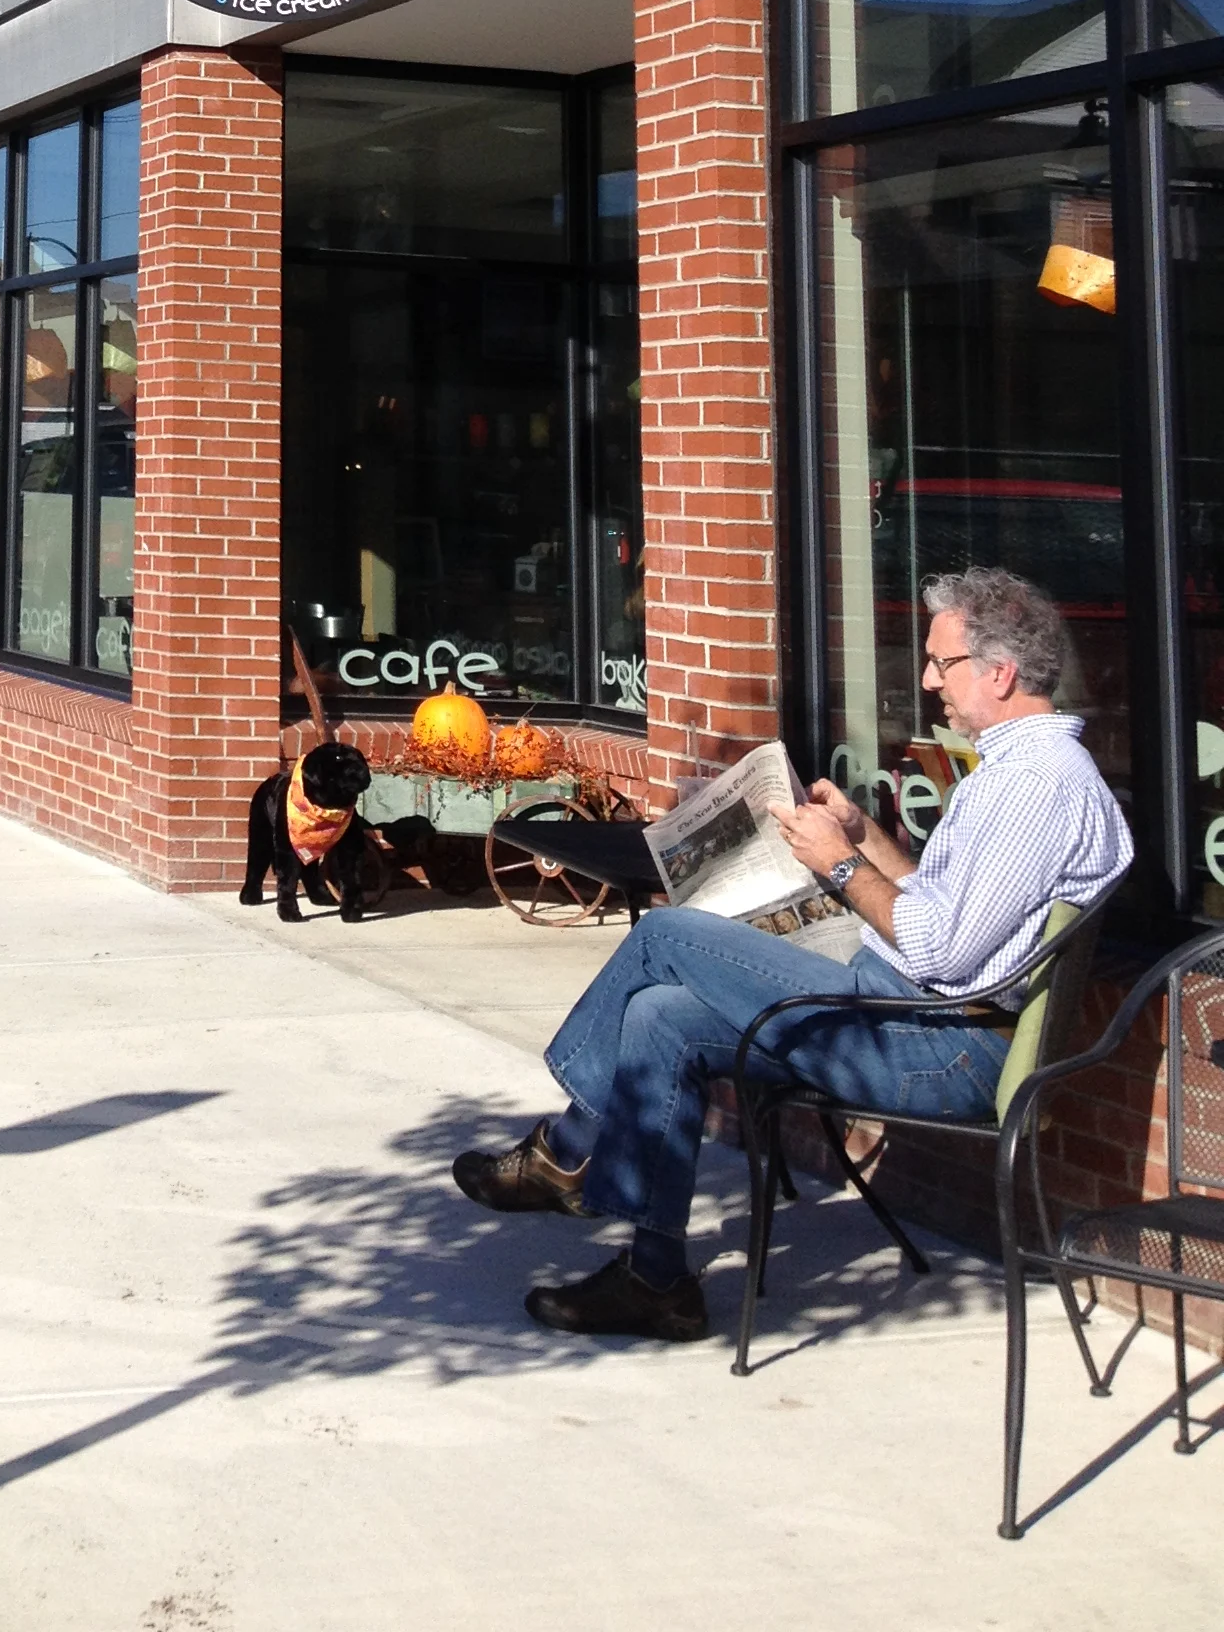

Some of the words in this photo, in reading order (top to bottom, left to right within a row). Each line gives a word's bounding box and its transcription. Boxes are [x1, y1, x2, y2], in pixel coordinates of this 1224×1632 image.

[338, 639, 500, 692] cafe
[601, 650, 646, 692] bak
[677, 818, 695, 833] The
[695, 804, 712, 821] New
[711, 786, 734, 809] York
[732, 765, 756, 790] Times
